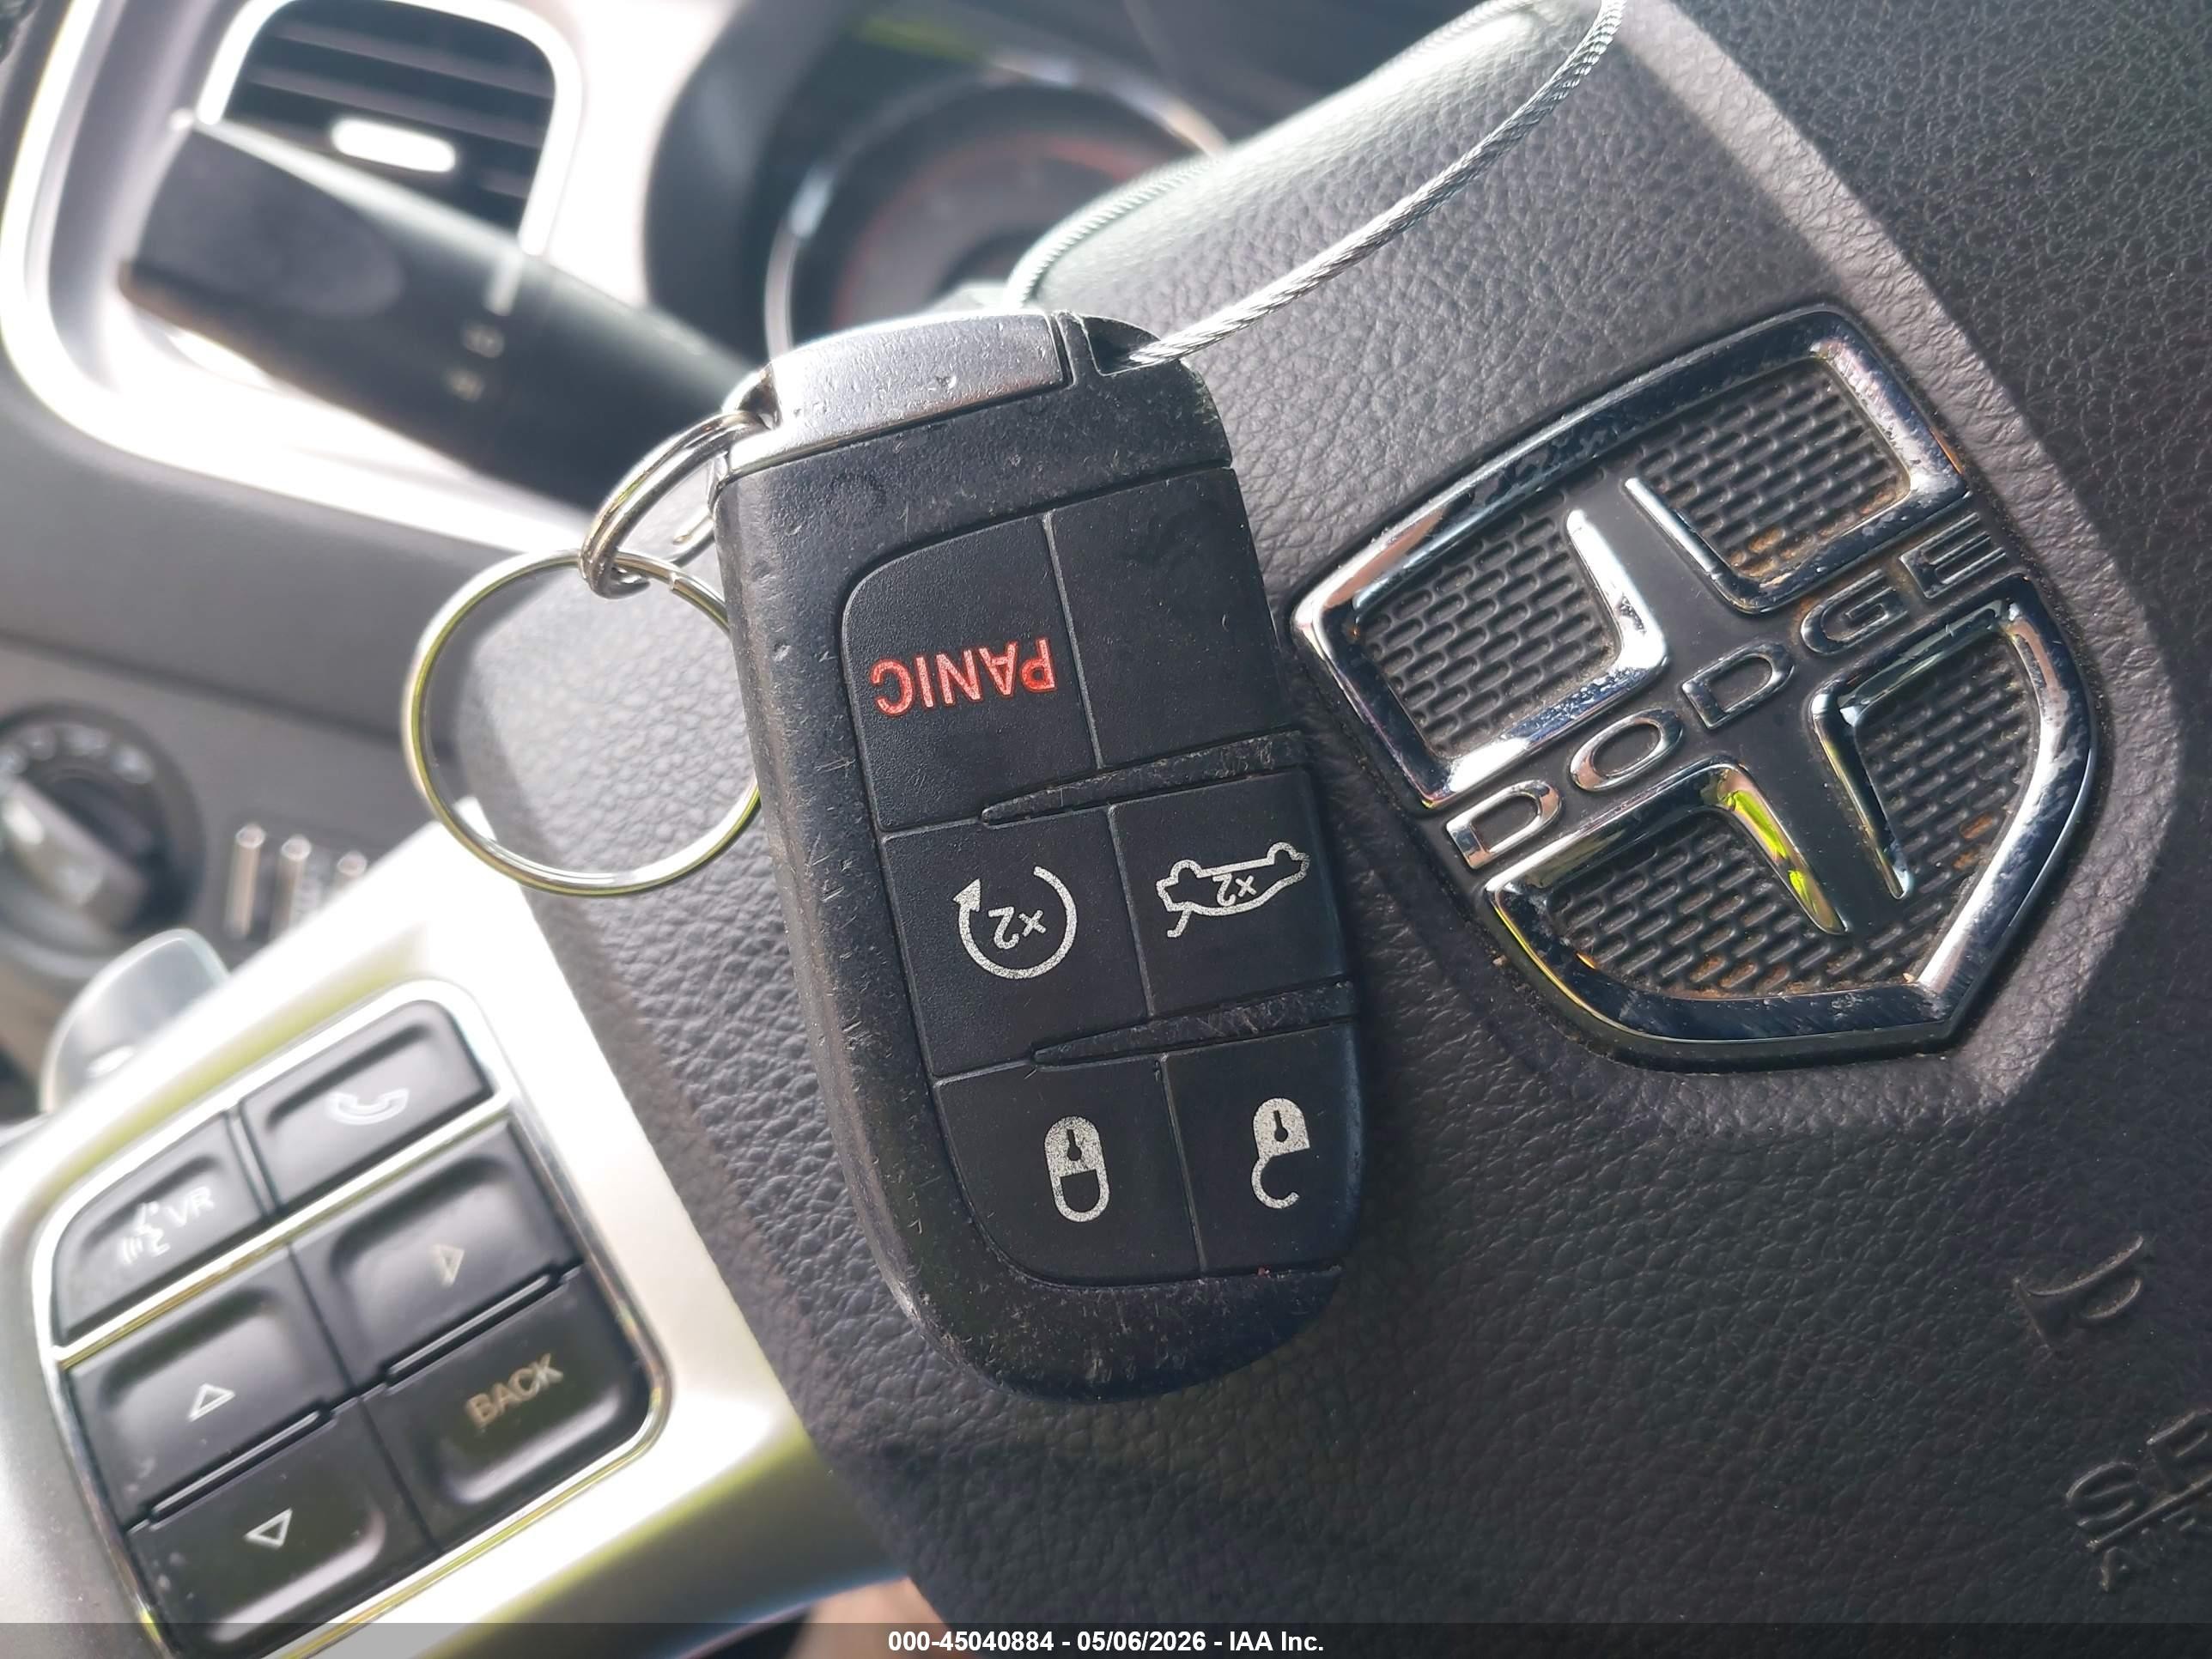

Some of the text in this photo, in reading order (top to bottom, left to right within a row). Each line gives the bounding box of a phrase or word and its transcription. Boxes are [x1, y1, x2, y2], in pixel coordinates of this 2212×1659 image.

[870, 637, 1058, 718] PANIC
[1445, 512, 2009, 870] DODGE
[162, 1186, 215, 1228] VR
[466, 1352, 563, 1429] BACK
